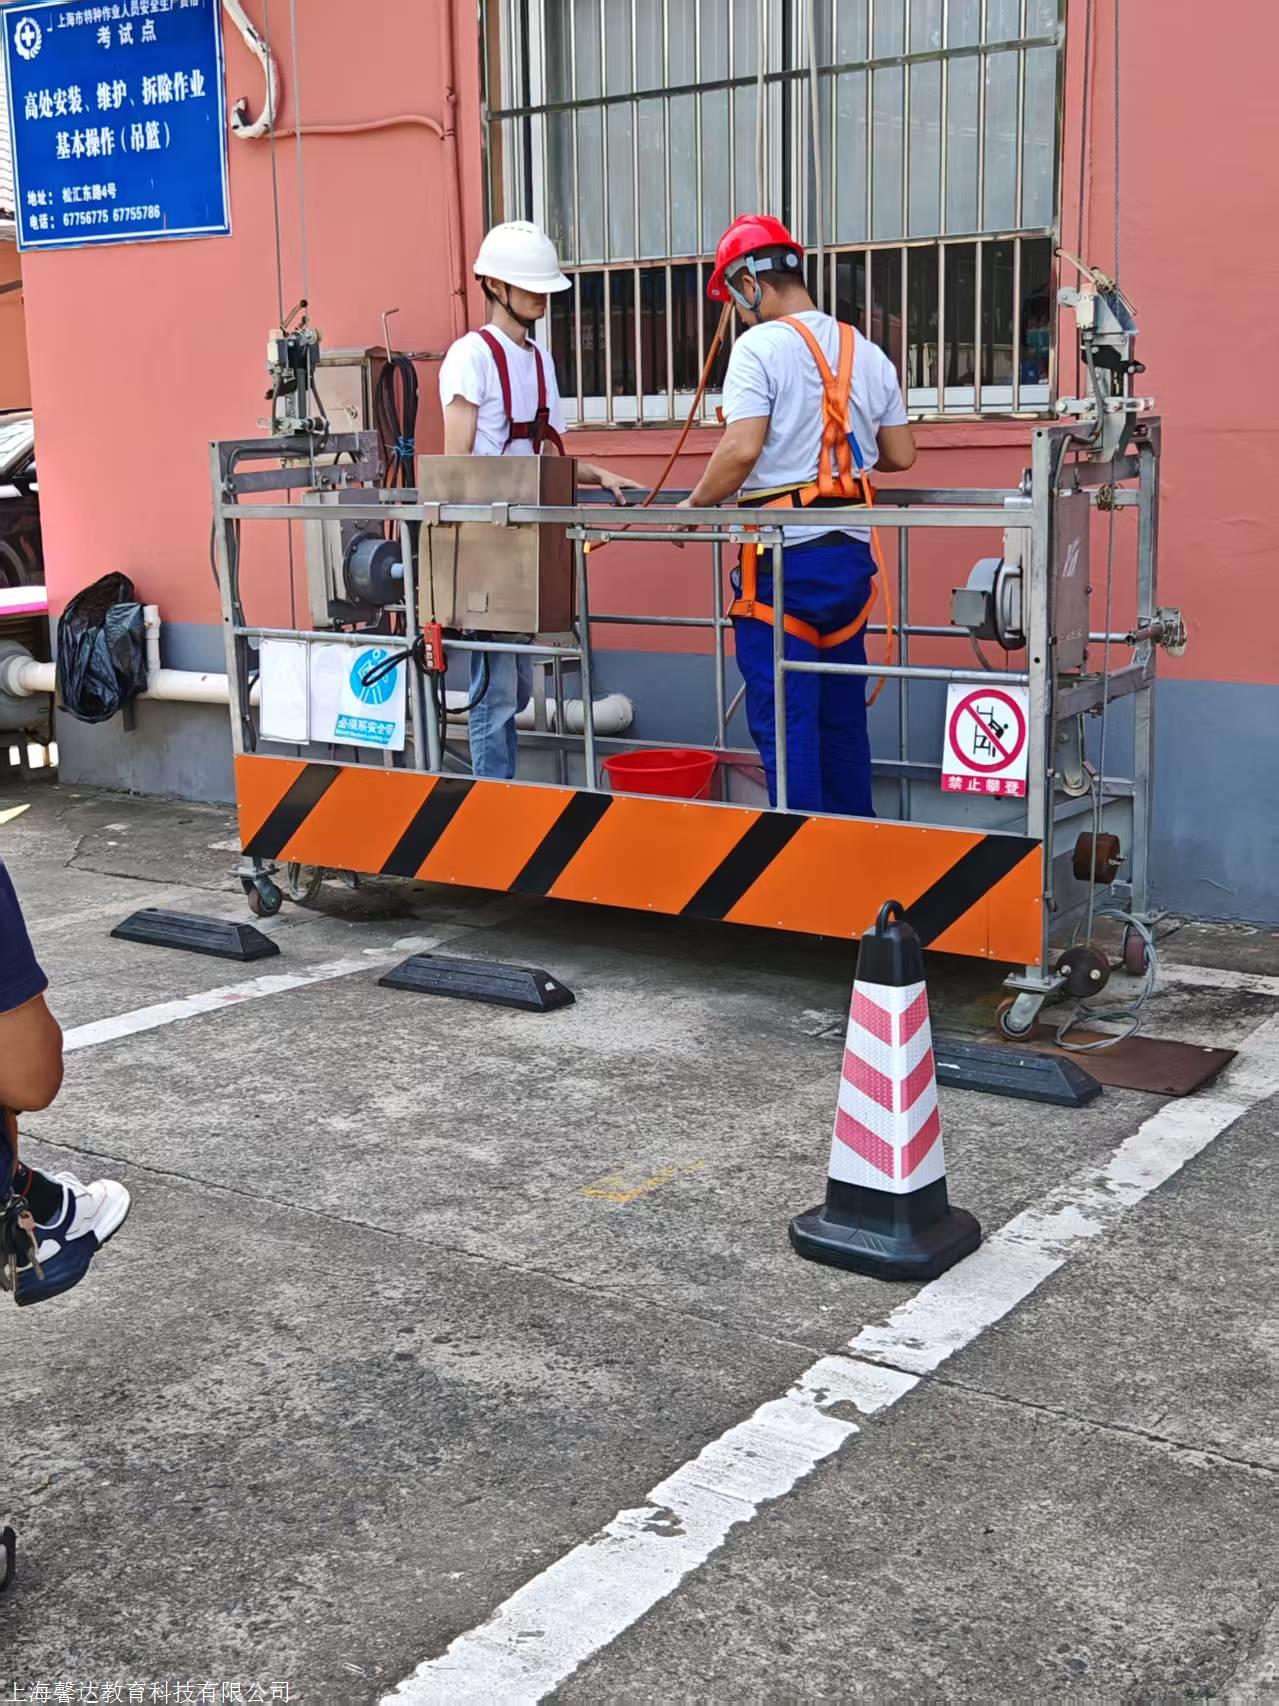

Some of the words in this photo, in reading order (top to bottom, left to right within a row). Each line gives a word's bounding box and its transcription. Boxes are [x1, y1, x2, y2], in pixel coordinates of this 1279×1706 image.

[96, 19, 157, 49] 考试点
[24, 69, 206, 120] 高处安装、维护、拆除作业
[63, 209, 109, 227] 67756775
[113, 204, 160, 222] 67755786
[947, 776, 1020, 796] 禁止攀登
